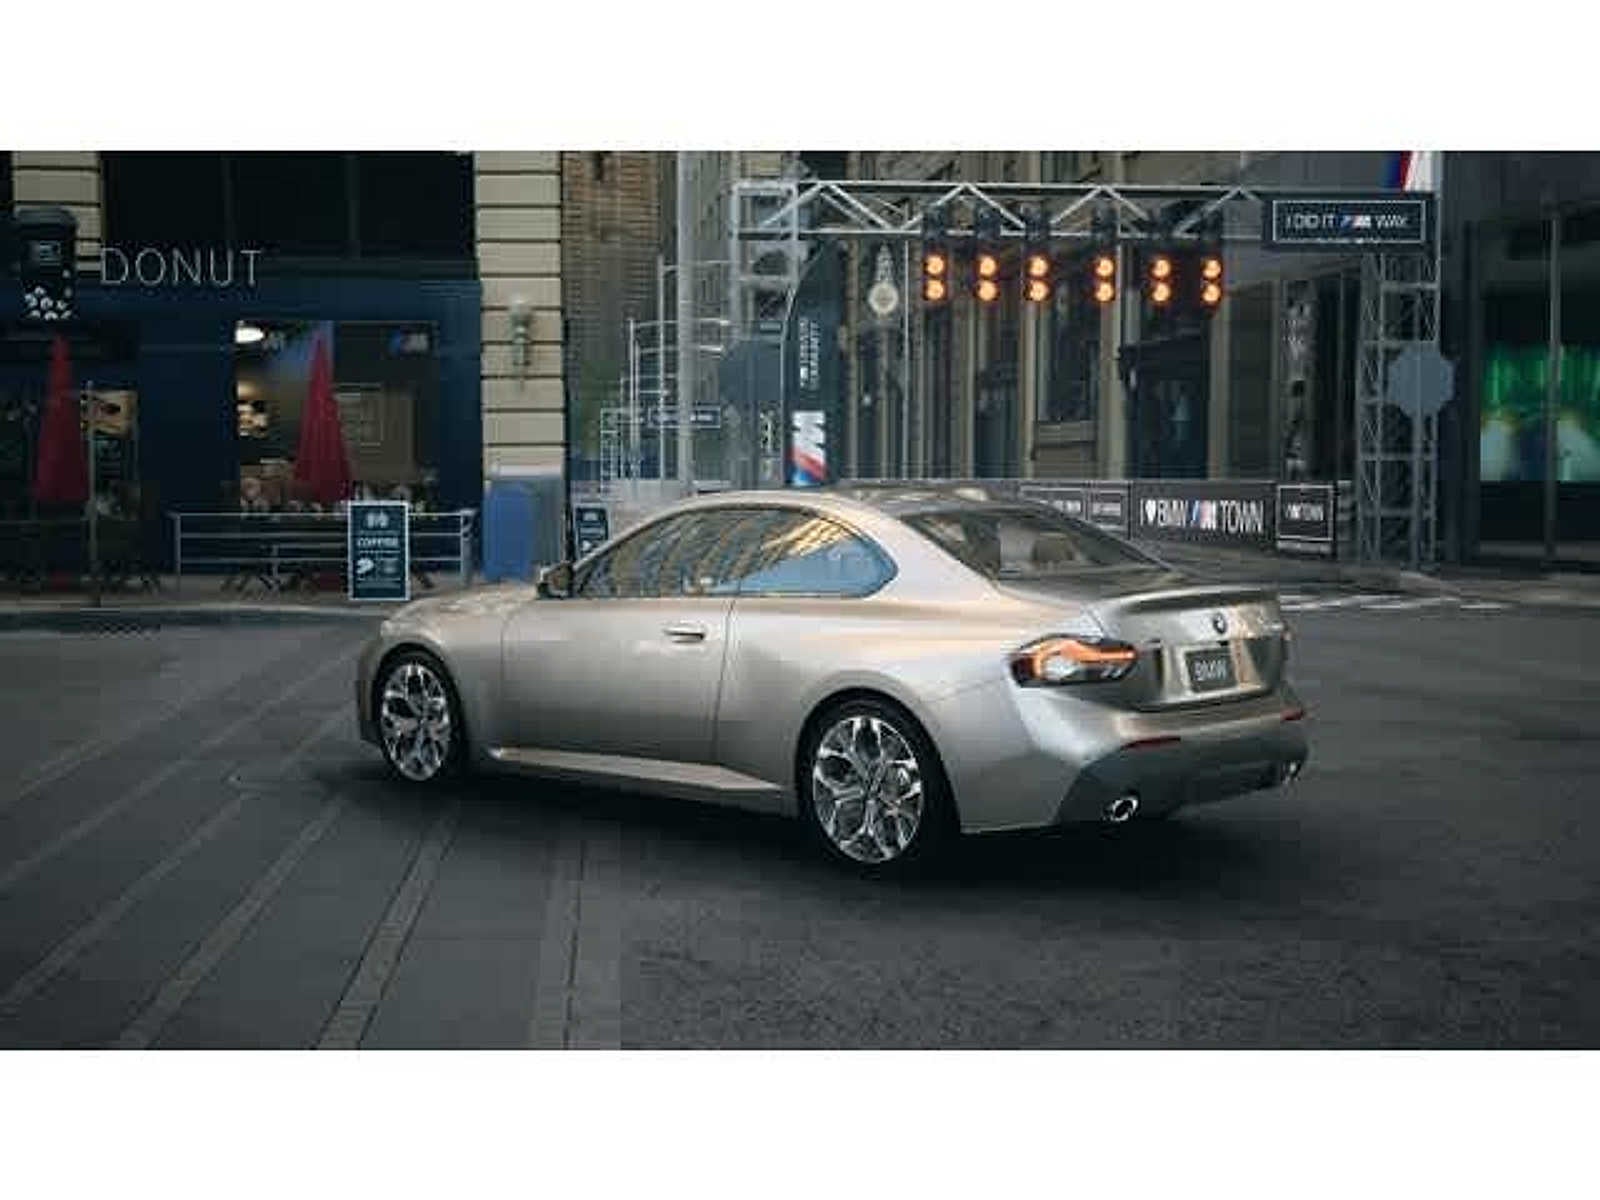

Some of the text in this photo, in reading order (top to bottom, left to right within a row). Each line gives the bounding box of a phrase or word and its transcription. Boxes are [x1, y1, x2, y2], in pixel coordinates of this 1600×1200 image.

[100, 247, 263, 287] DONUT
[1158, 499, 1187, 528] BMW
[1220, 499, 1264, 534] TOWN
